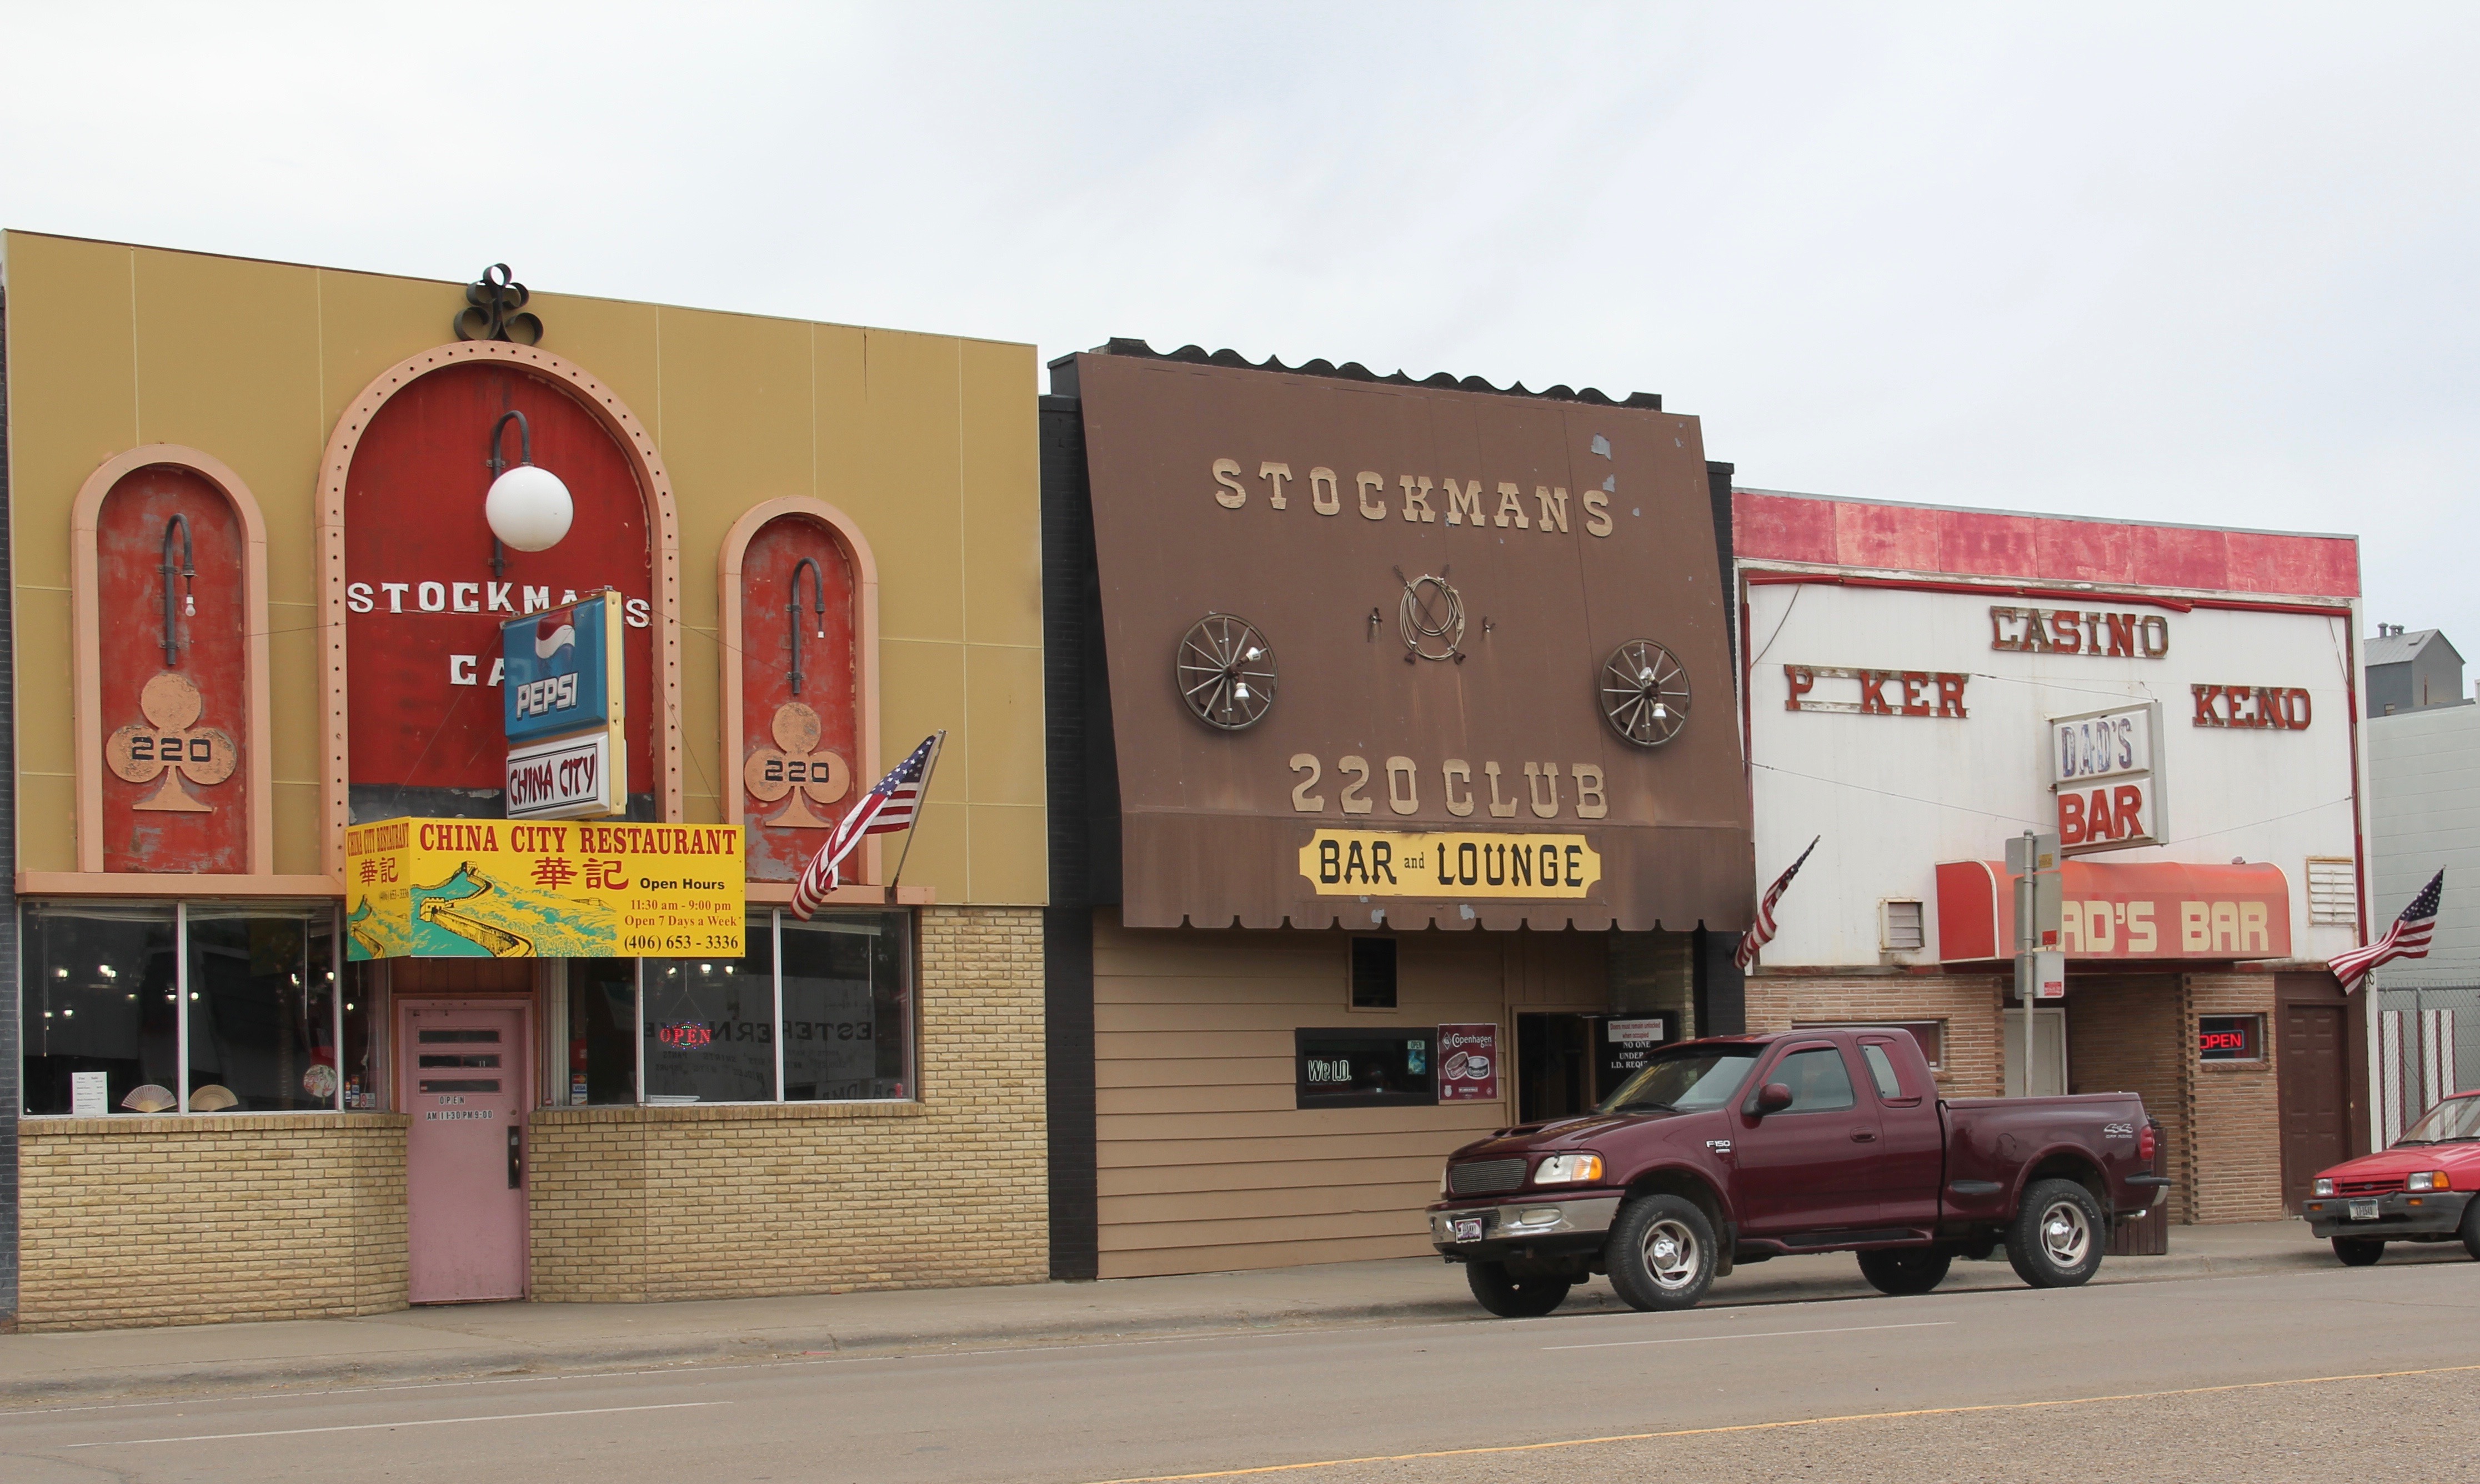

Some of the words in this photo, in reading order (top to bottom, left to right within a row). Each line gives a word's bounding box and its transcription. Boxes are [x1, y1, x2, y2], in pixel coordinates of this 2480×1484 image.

[1211, 458, 1613, 538] STOCKMANS
[1991, 605, 2168, 659] CASINO
[516, 671, 579, 719] PEPSI
[2191, 684, 2311, 730] KENO
[132, 737, 212, 763] 220
[2061, 718, 2132, 778] DAD'S
[509, 760, 554, 806] CHINA
[559, 753, 595, 797] CITY
[765, 760, 829, 783] 220
[1289, 753, 1419, 816] 220
[1442, 758, 1608, 819] CLUB
[2058, 784, 2145, 845] BAR
[420, 824, 499, 851] CHINA
[511, 826, 567, 853] CITY
[580, 827, 737, 855] RESTAURANT
[359, 856, 399, 887] 華記
[530, 856, 629, 890] 華記
[1319, 839, 1397, 885] BAR
[1404, 853, 1425, 870] and
[1437, 842, 1584, 887] LOUNGE
[640, 878, 678, 891] Open
[683, 878, 725, 890] Hours
[625, 916, 655, 928] Open
[659, 916, 664, 925] 7
[668, 916, 694, 928] Days
[708, 915, 737, 926] Week
[631, 900, 658, 910] 11:30
[689, 900, 711, 910] 9:00
[714, 903, 731, 913] pm
[2061, 900, 2157, 952] AD'S
[2181, 901, 2269, 952] BAR
[624, 935, 662, 952] (406)
[667, 935, 692, 949] 653
[706, 935, 739, 949] 3336
[659, 1028, 712, 1044] OPEN
[1452, 1033, 1492, 1048] Copenhagen
[2200, 1034, 2242, 1049] OPEN
[1309, 1060, 1330, 1081] We
